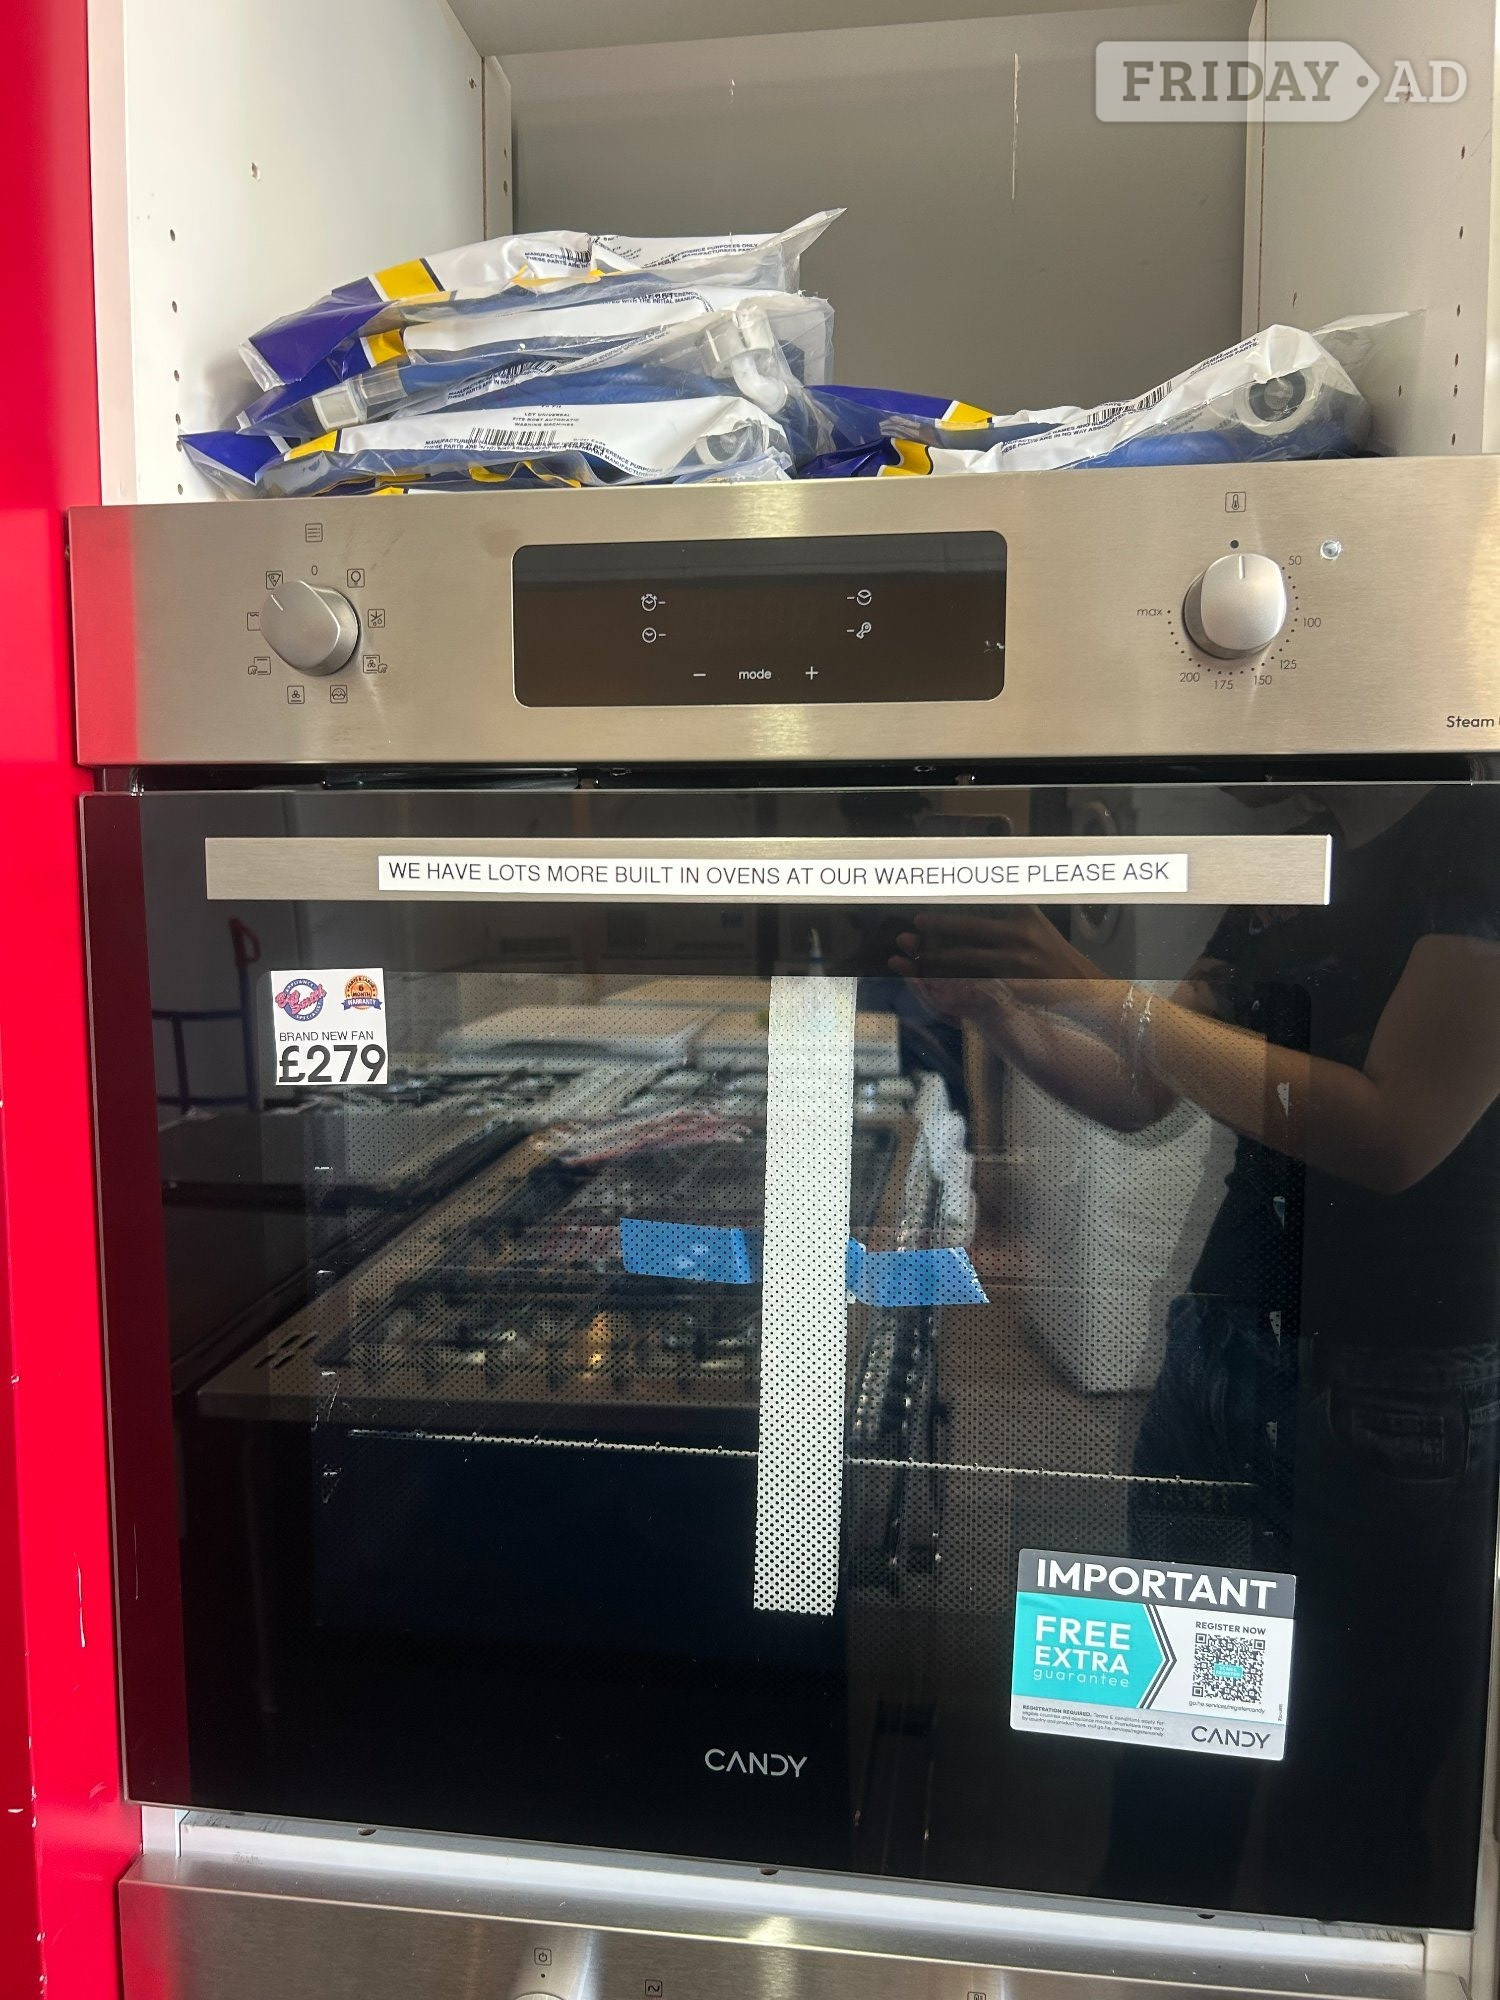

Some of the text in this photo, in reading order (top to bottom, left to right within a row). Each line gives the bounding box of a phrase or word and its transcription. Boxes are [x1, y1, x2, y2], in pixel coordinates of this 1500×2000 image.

[1288, 555, 1303, 566] 50
[1136, 607, 1163, 617] max
[1303, 617, 1322, 628] 100
[1280, 659, 1298, 670] 125
[738, 668, 772, 681] mode
[1180, 672, 1201, 683] 200
[1253, 675, 1273, 685] 150
[1214, 680, 1234, 690] 175
[1446, 715, 1495, 728] Steam
[389, 861, 1170, 886] WE HAVE LOTS MORE BUILT IN OVENS AT OUR WAREHOUSE PLEASE ASK
[279, 1030, 374, 1042] BRAND NEW FAN
[278, 1043, 386, 1083] £279
[1036, 1558, 1277, 1610] IMPORTANT
[1035, 1614, 1132, 1651] FREE
[1195, 1621, 1267, 1636] REGISTER NOW
[1035, 1646, 1129, 1675] EXTRA
[1033, 1667, 1130, 1688] guarantee
[1022, 1705, 1062, 1714] REGISTRATION
[1191, 1725, 1271, 1749] CANDY
[704, 1748, 808, 1778] CANDY
